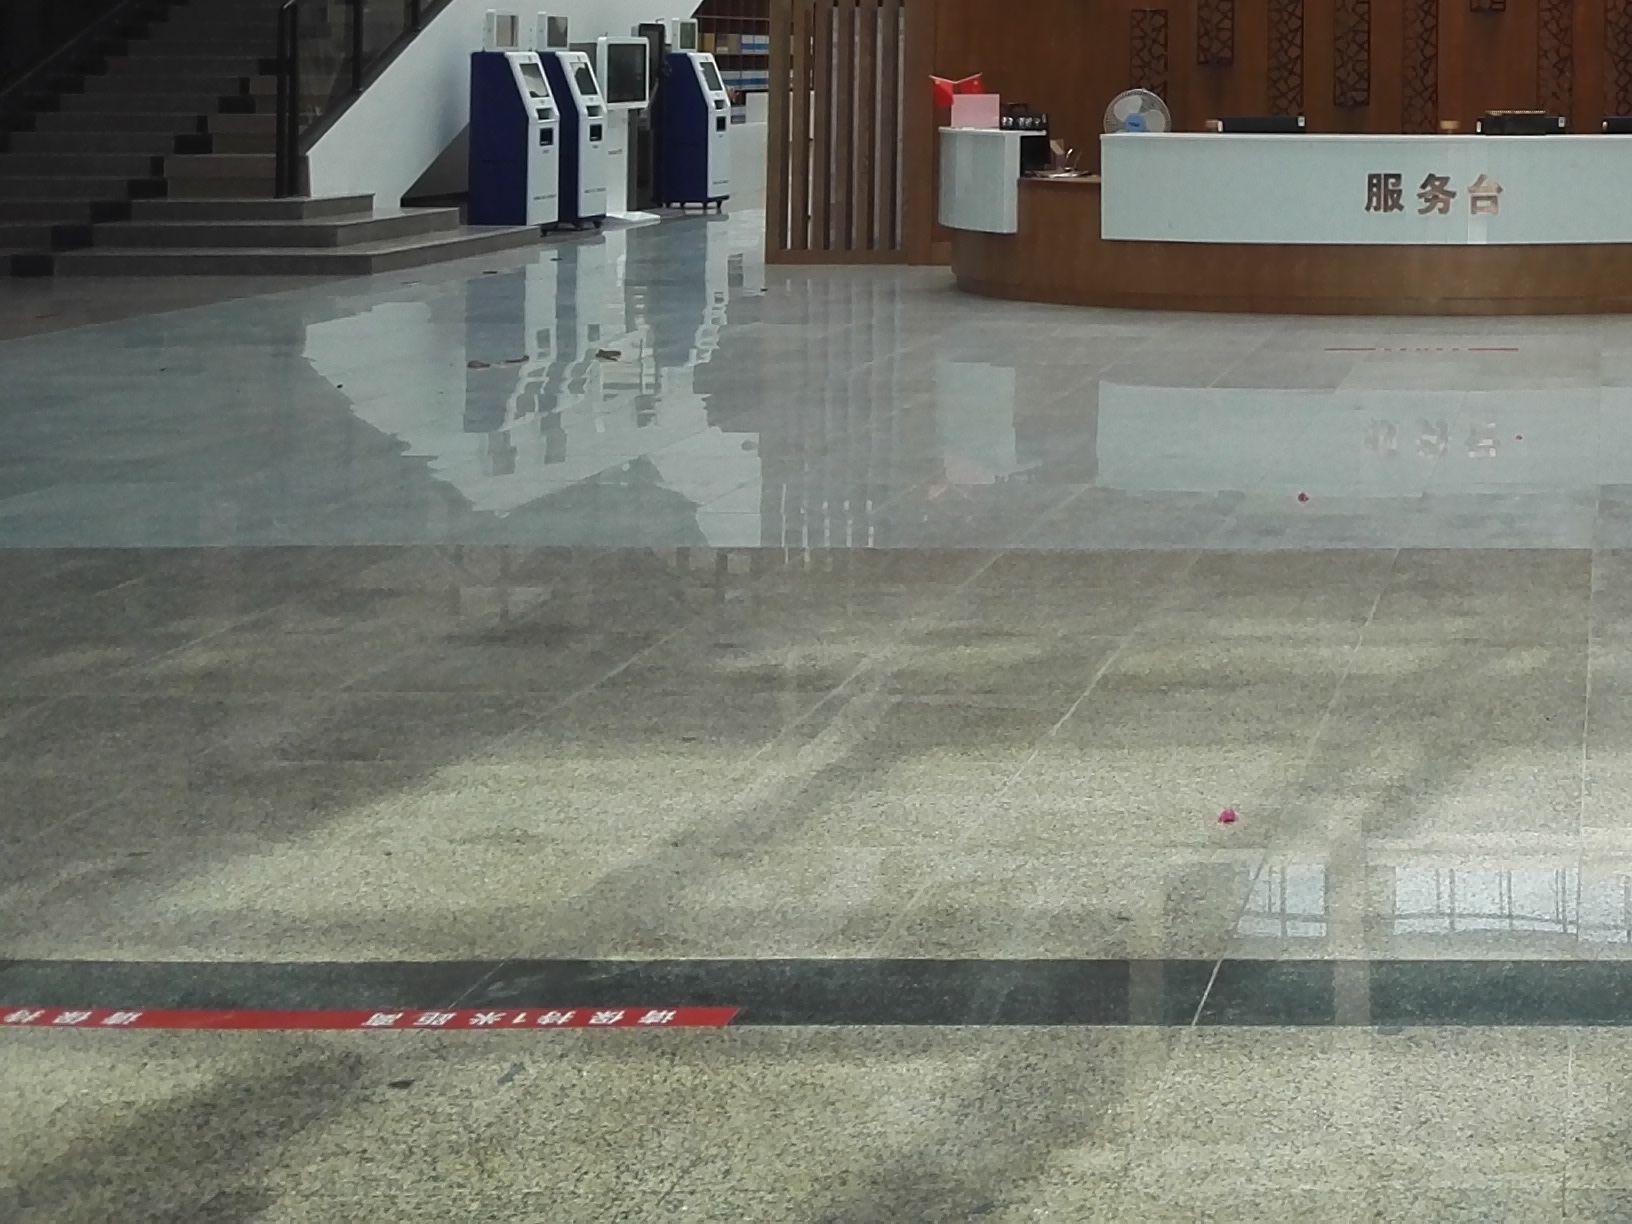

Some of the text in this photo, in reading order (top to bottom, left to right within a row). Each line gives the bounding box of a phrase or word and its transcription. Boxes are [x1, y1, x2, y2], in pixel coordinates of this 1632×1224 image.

[1364, 172, 1504, 215] 服务台
[361, 1009, 678, 1027] 请保持1米距离
